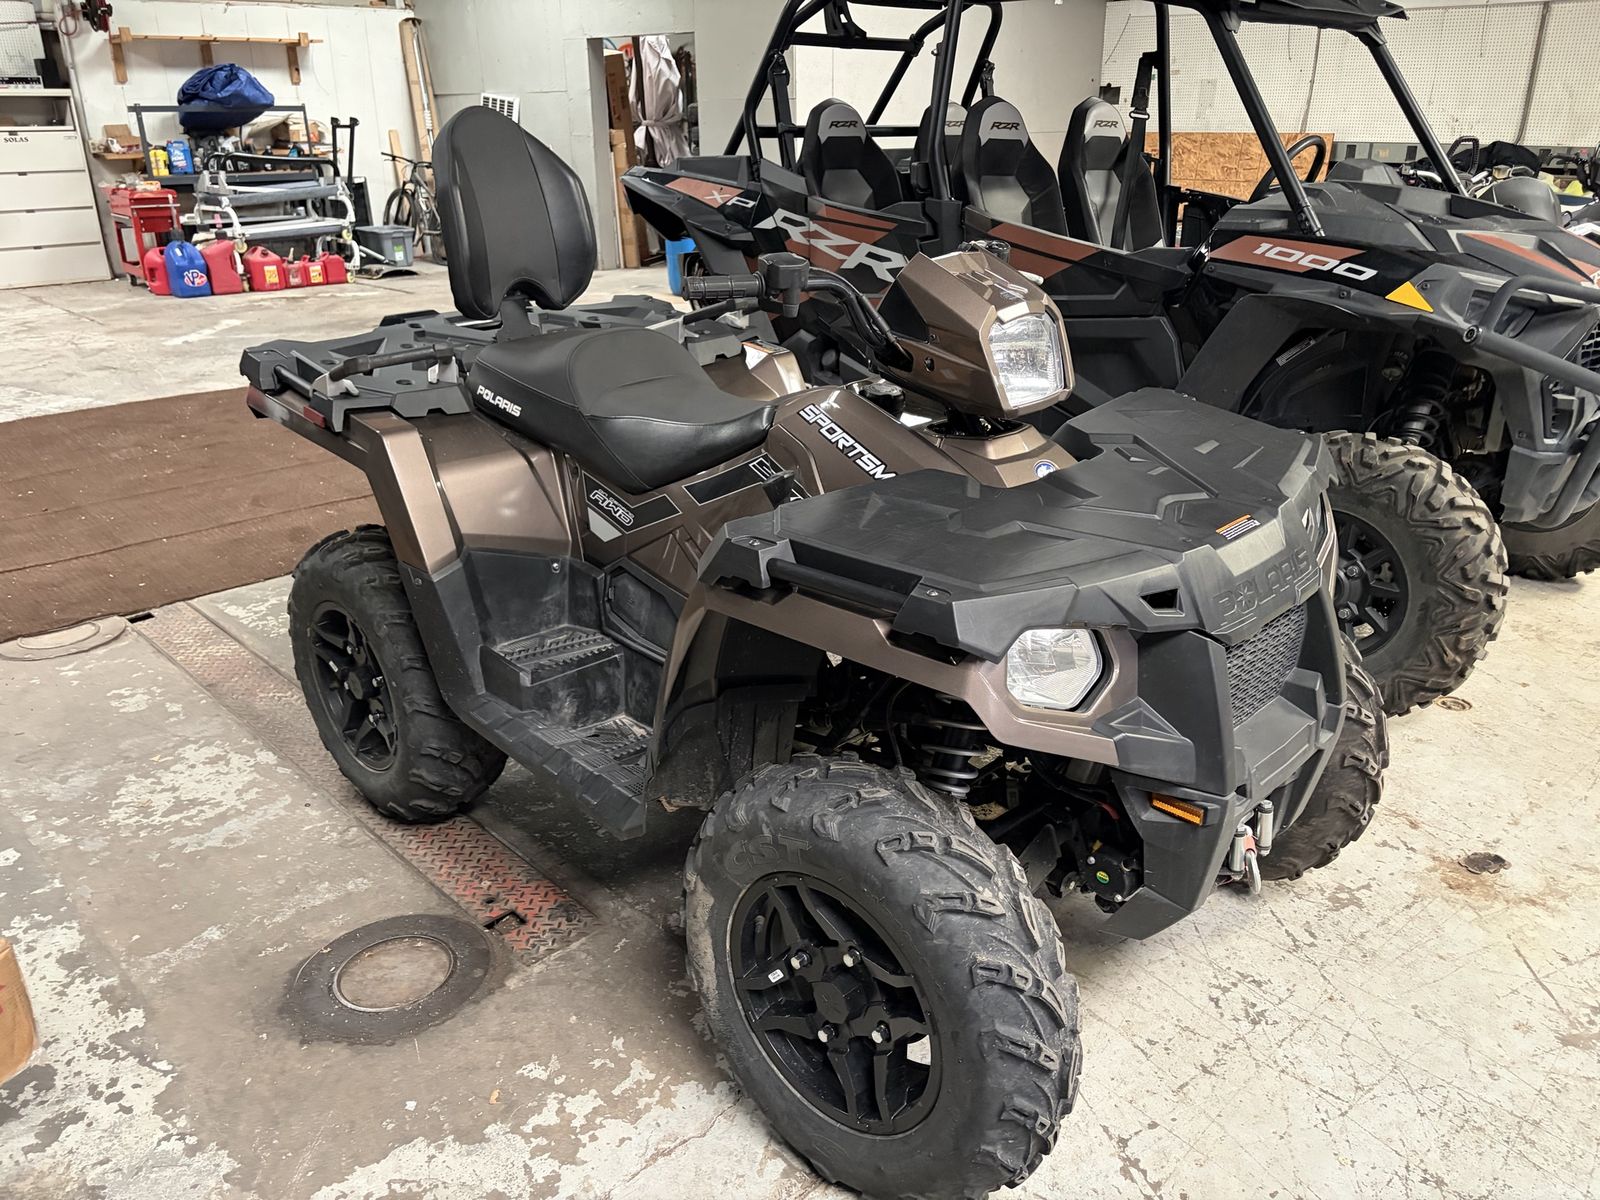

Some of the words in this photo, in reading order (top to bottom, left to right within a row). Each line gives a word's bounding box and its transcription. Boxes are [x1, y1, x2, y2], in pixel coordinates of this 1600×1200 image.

[828, 120, 858, 129] RZR
[990, 121, 1020, 131] RZR
[1093, 120, 1118, 128] RZR
[704, 190, 756, 208] XP
[753, 208, 909, 283] RZR
[1253, 242, 1378, 281] 1000
[476, 384, 522, 417] POLARIS
[589, 489, 634, 527] AWD
